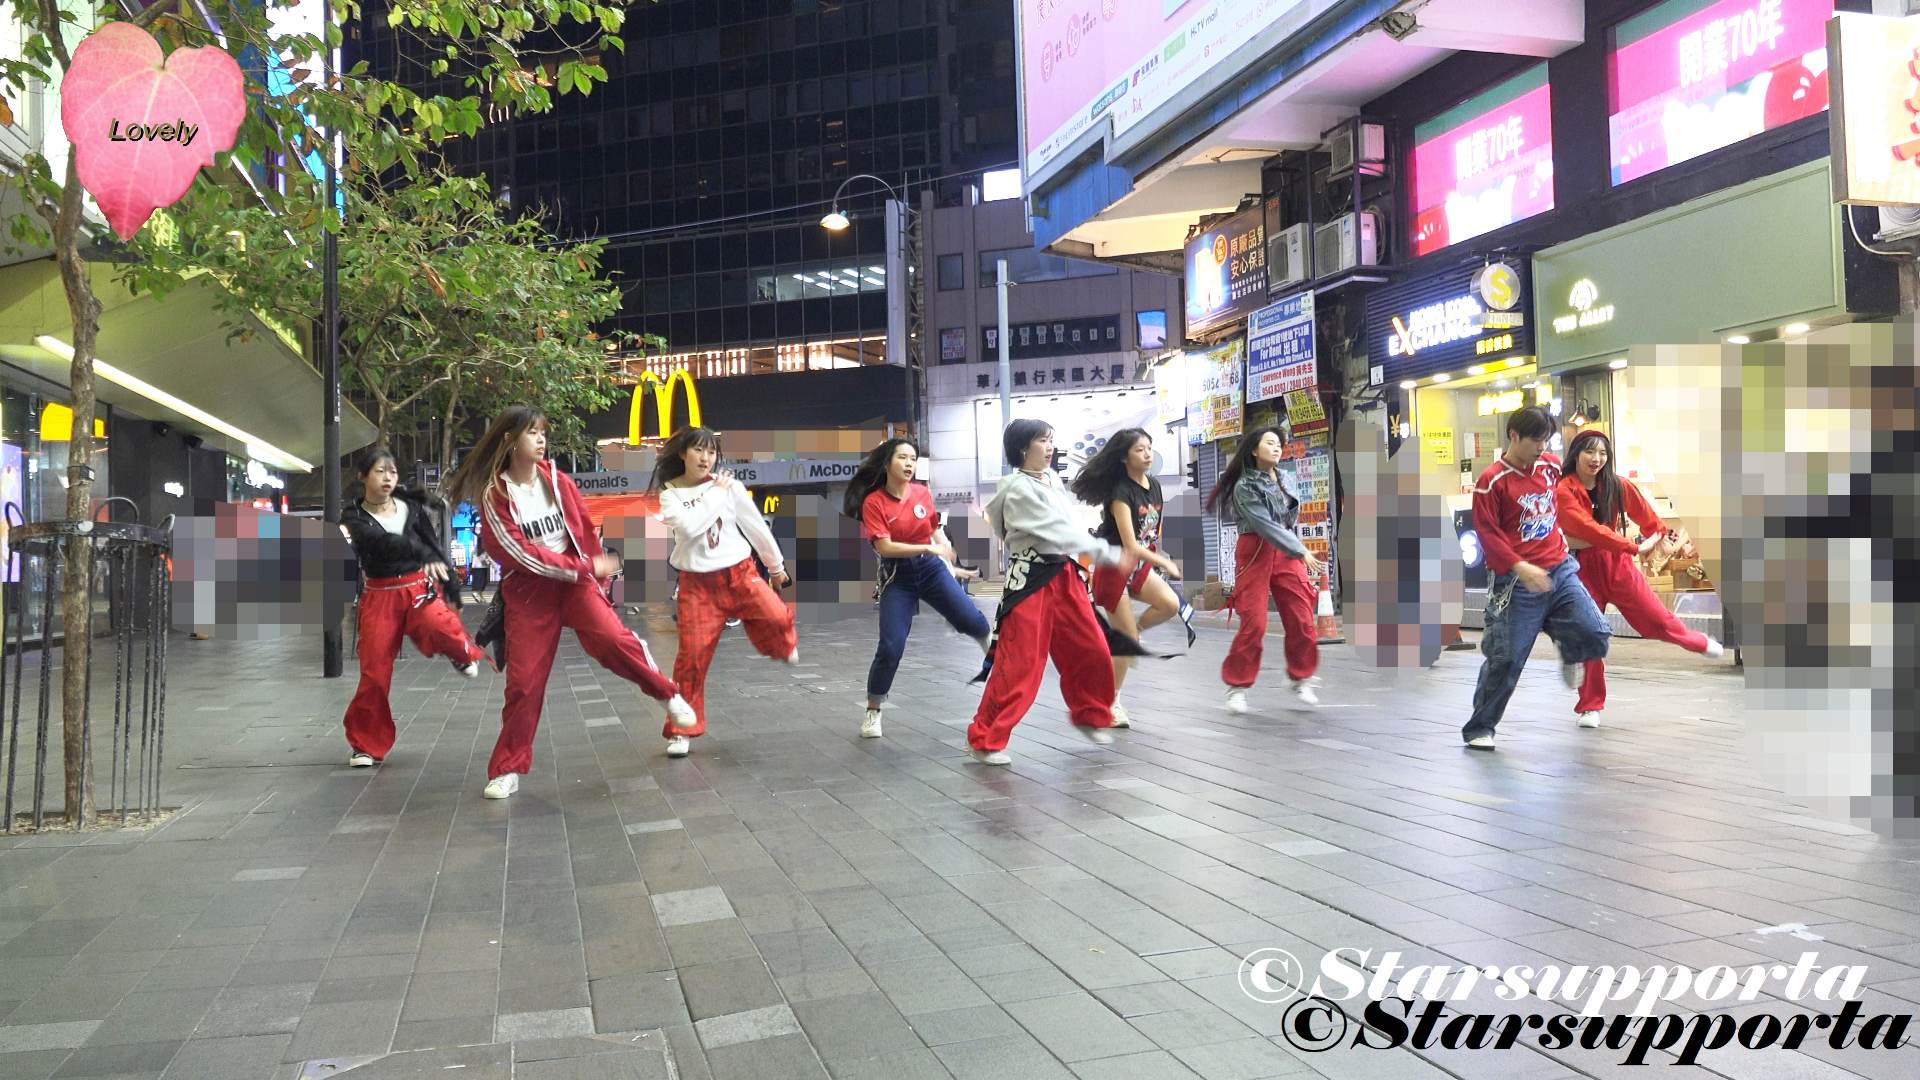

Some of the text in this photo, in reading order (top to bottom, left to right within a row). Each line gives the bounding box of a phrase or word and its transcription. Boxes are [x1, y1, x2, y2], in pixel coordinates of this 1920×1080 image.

[976, 364, 1125, 389] 華銀行東區大廈
